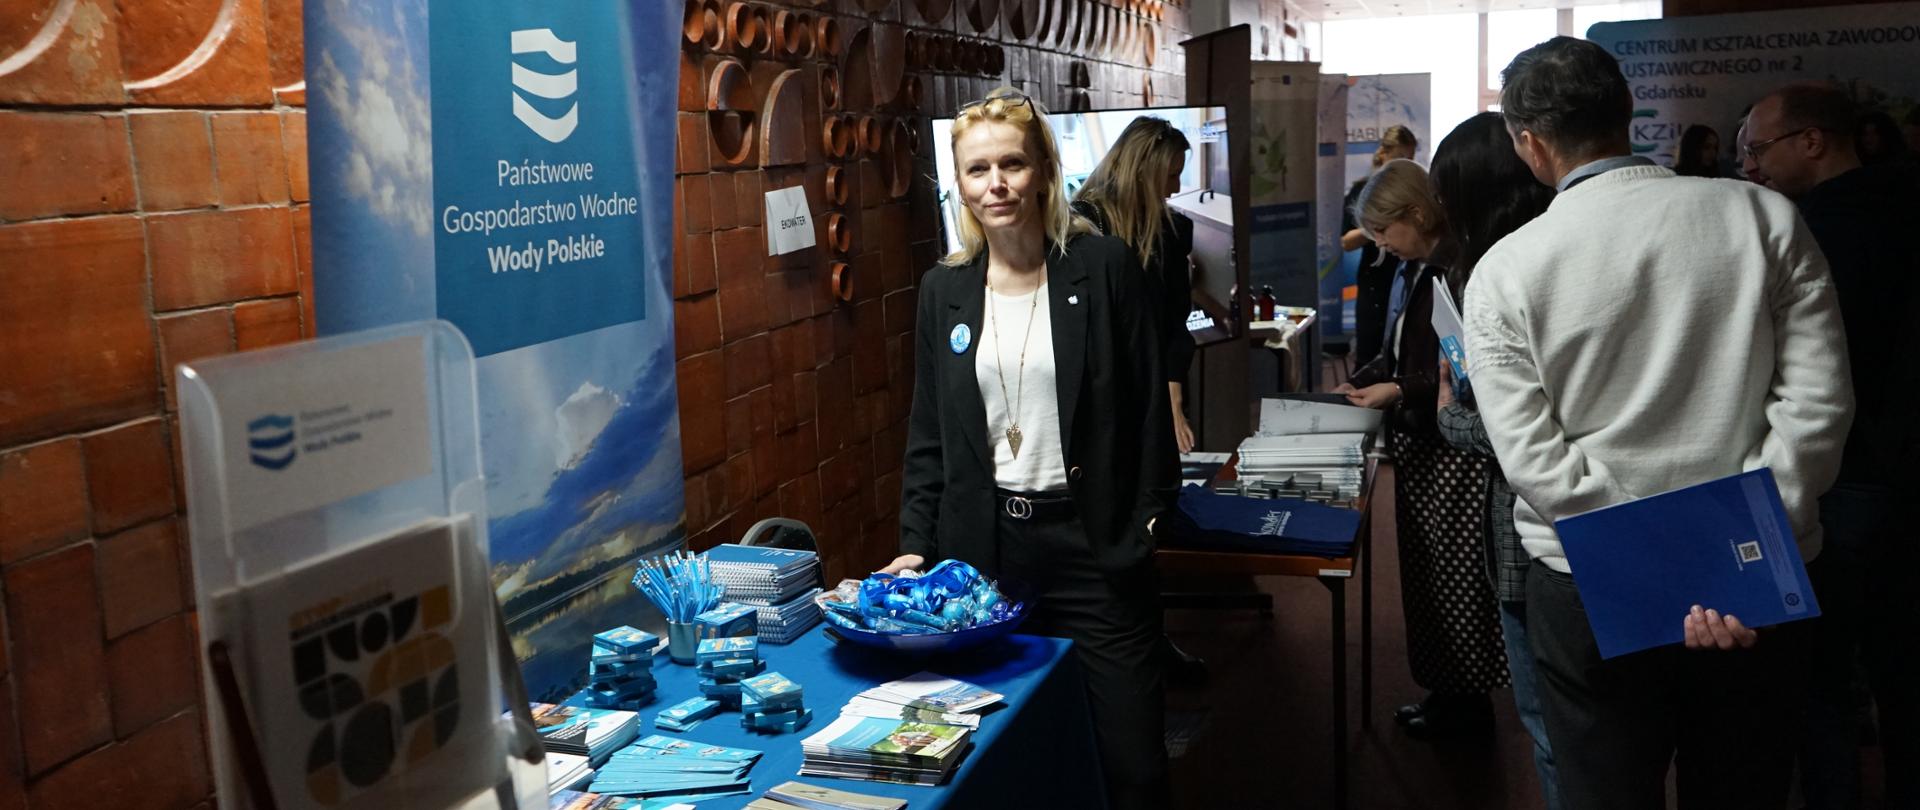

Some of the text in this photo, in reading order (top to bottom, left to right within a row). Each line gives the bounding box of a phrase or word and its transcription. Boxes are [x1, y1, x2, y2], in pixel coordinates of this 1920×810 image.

[1614, 25, 1920, 55] CENTRUM KSZTAŁCENIA ZAWODO
[1625, 55, 1803, 78] USTAWICZNEGO nr 2
[1634, 83, 1707, 100] Gdańsku
[498, 158, 593, 186] Państwowe
[443, 192, 637, 236] Gospodarstwo Wodne
[488, 234, 604, 273] Wody Polskie
